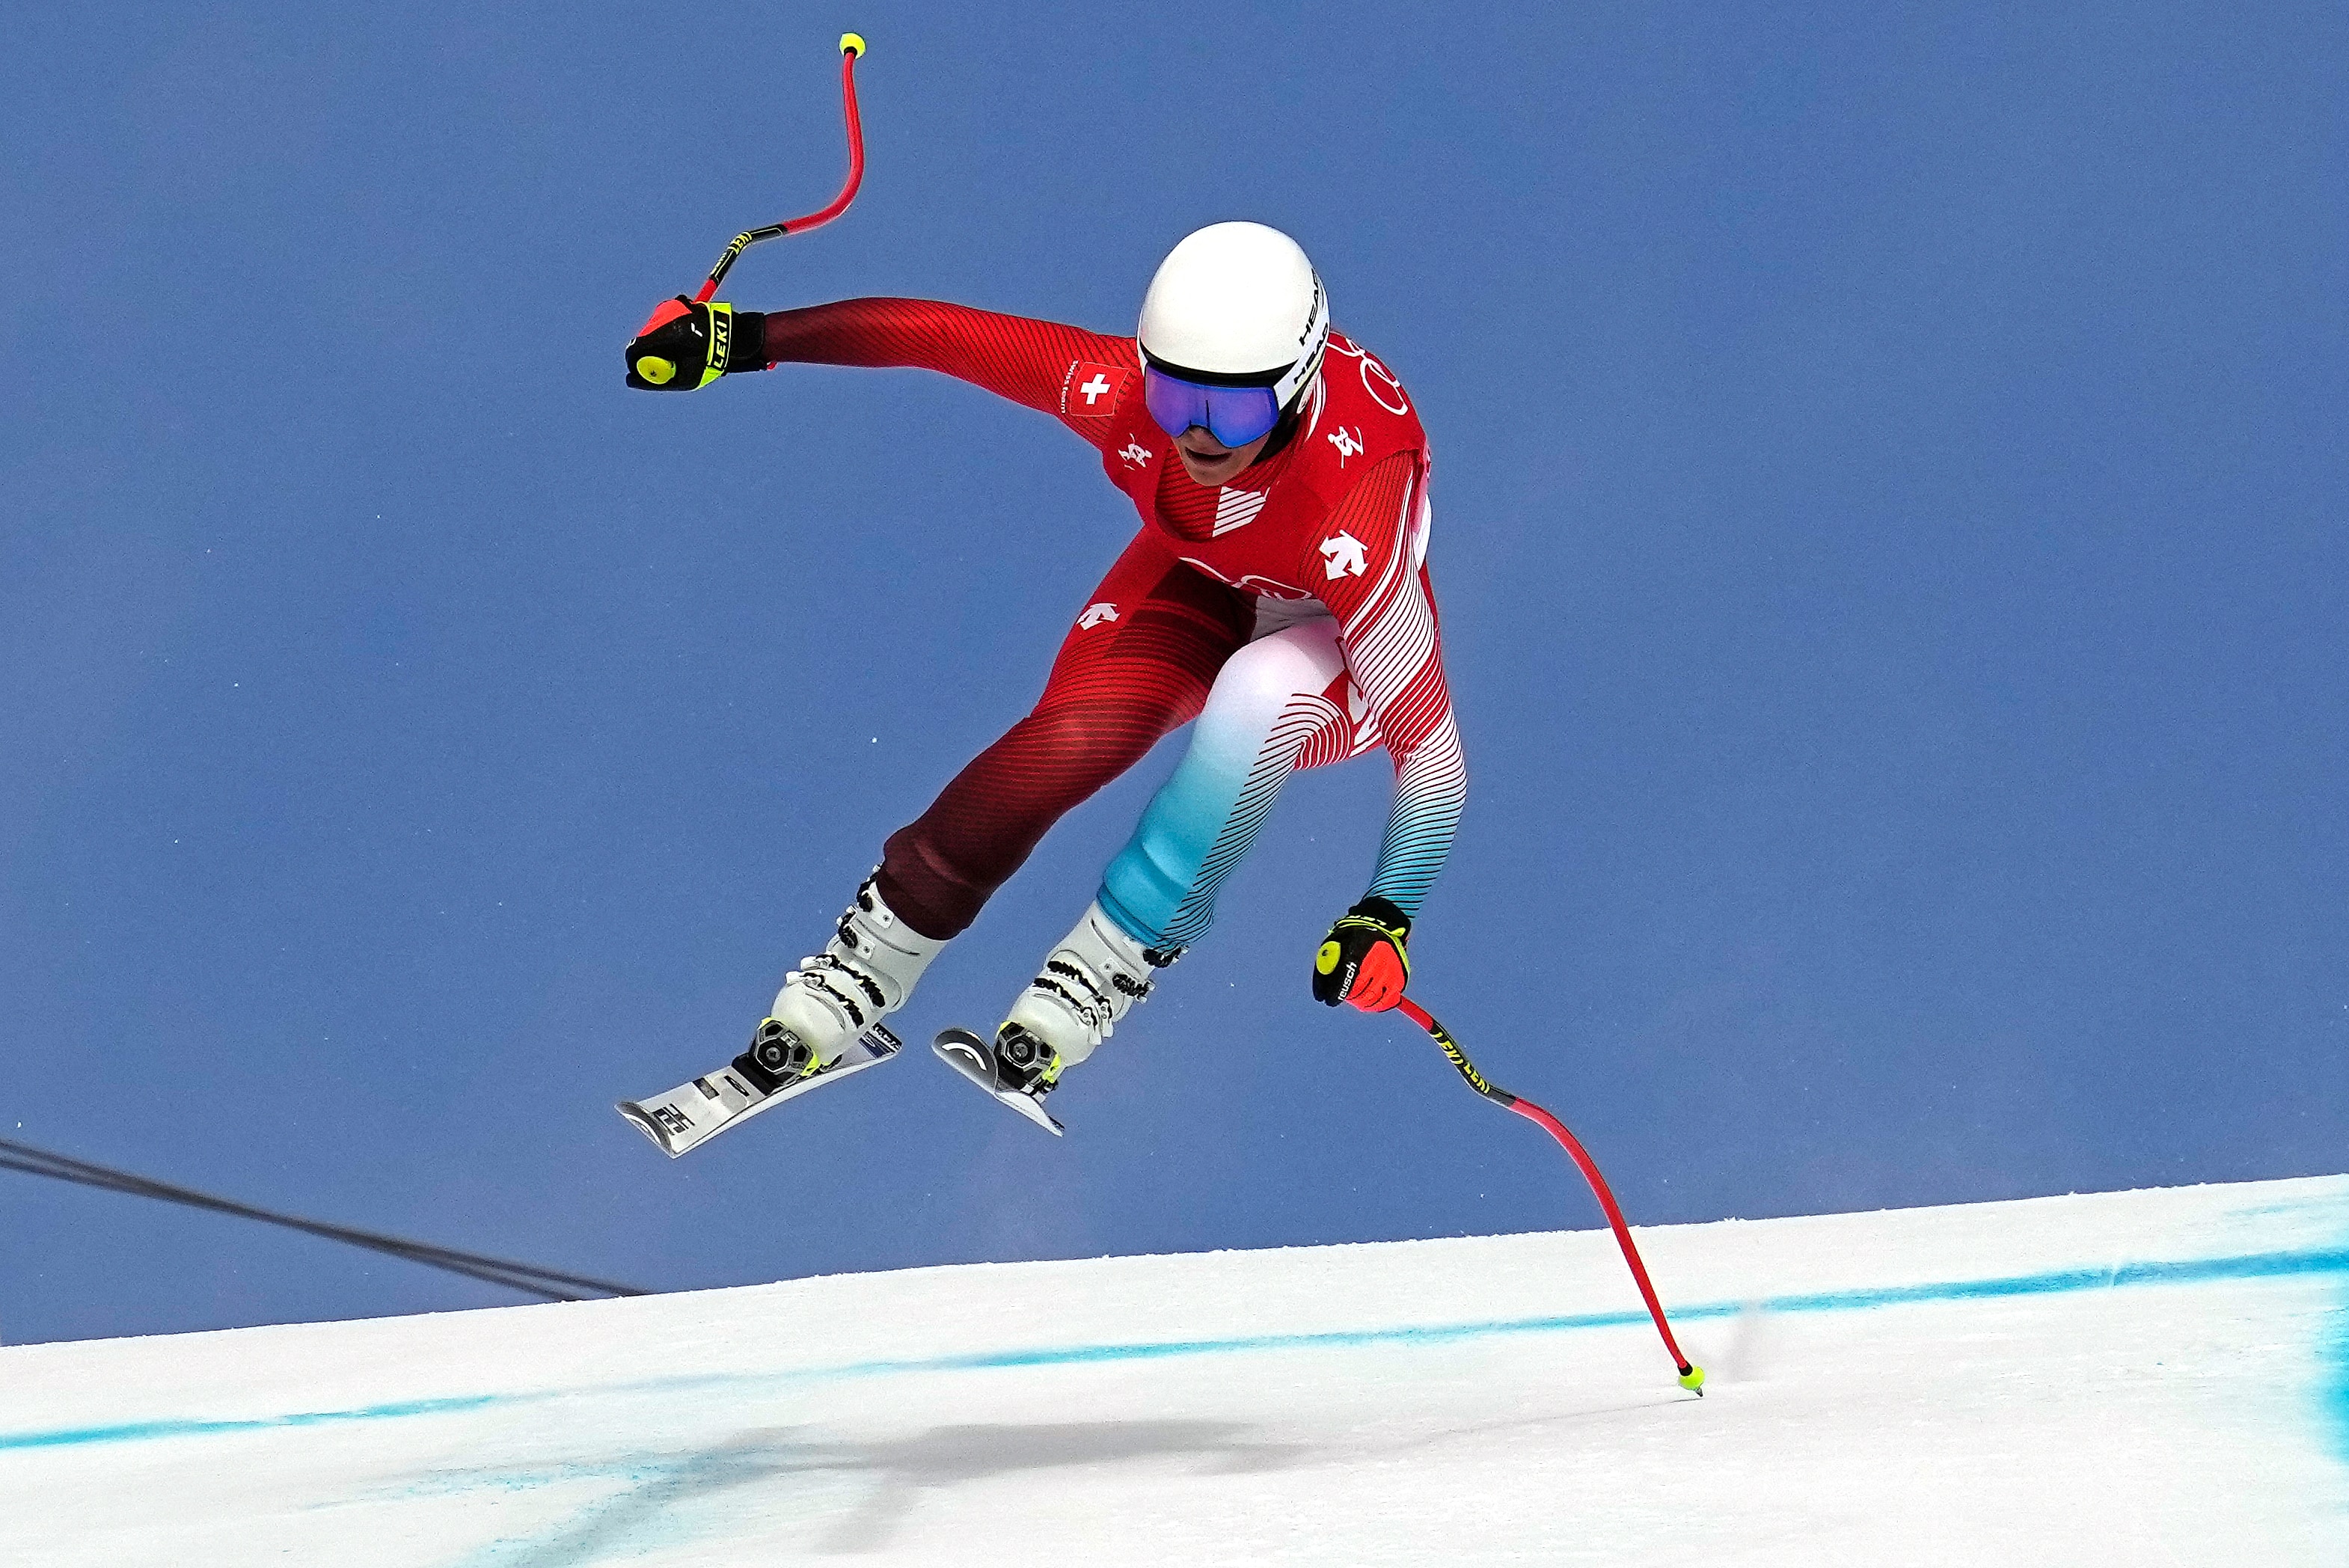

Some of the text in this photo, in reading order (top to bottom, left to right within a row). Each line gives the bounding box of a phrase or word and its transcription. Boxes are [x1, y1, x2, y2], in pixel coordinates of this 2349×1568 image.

[713, 320, 729, 369] LEKI
[1293, 322, 1329, 385] HEAD
[1338, 961, 1357, 1001] reusch
